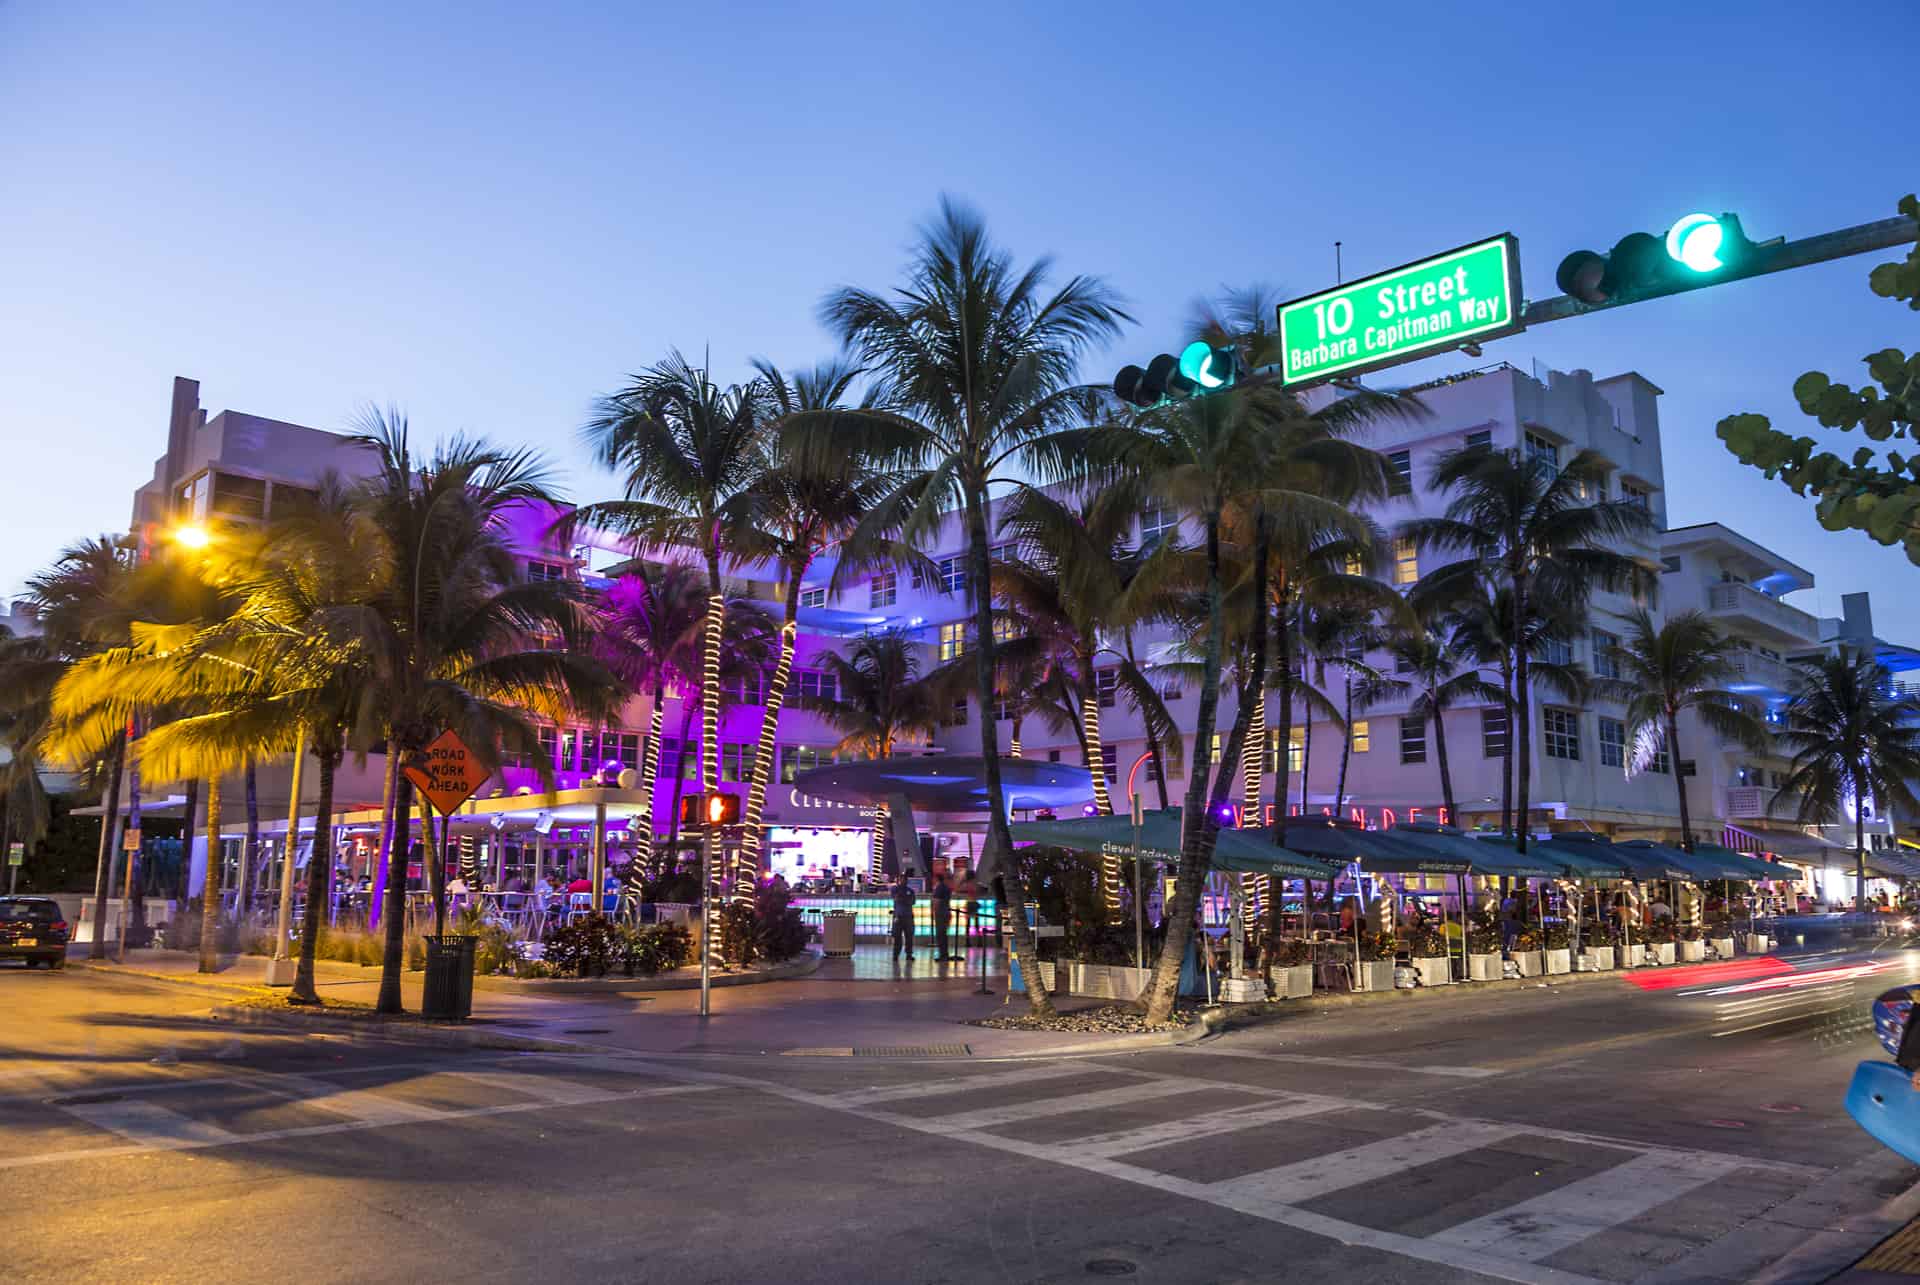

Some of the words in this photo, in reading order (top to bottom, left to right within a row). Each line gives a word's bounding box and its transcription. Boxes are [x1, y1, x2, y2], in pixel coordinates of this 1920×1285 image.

[1313, 297, 1354, 340] 10
[1377, 265, 1469, 319] Street
[1291, 337, 1358, 371] Barbara
[1364, 309, 1452, 349] Capitman
[1459, 295, 1499, 324] Way
[432, 748, 465, 761] ROAD
[432, 764, 465, 777] WORK
[428, 780, 469, 792] AHEAD
